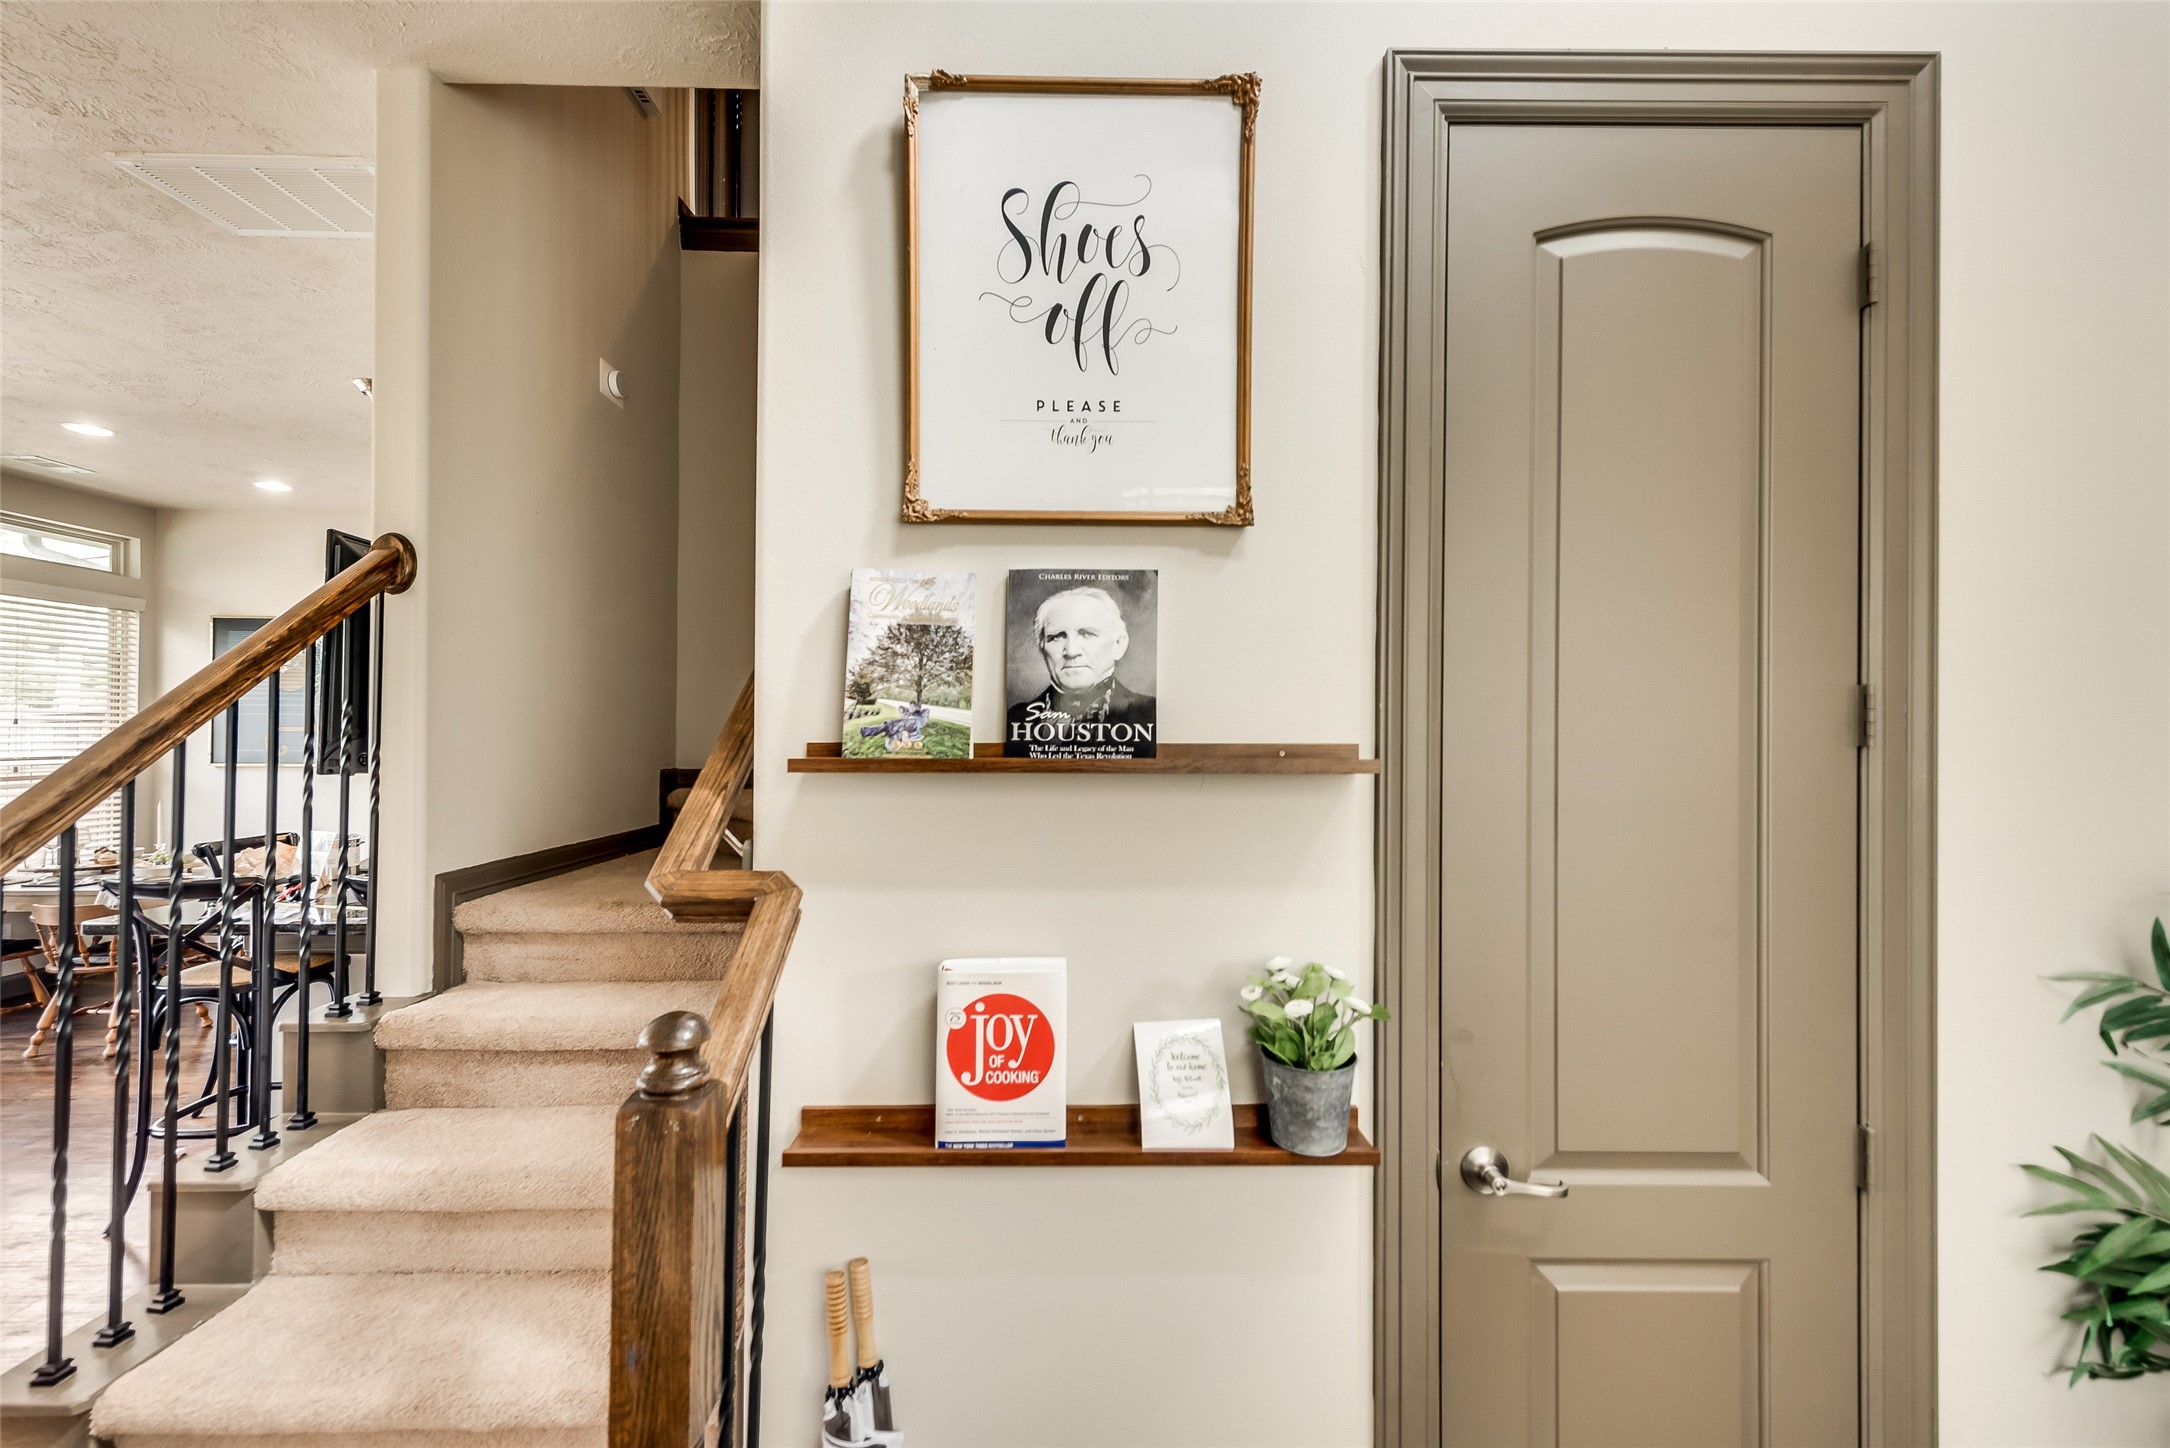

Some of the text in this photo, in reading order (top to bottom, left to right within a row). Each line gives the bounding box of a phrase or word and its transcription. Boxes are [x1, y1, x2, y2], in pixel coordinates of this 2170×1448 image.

[996, 174, 1181, 292] Shoes
[1036, 400, 1121, 413] PLEASE
[1051, 424, 1113, 454] thank you
[1038, 573, 1072, 581] CHARLES
[1074, 573, 1096, 581] RIVER
[869, 582, 960, 613] Woodlands
[1025, 701, 1071, 721] Sam
[1010, 722, 1154, 742] HOUSTON
[1029, 744, 1044, 752] The
[1045, 744, 1059, 752] Life
[1074, 745, 1096, 753] Legacy
[949, 1011, 962, 1022] 75
[989, 1054, 1005, 1069] OF
[985, 1070, 1039, 1084] COOKING
